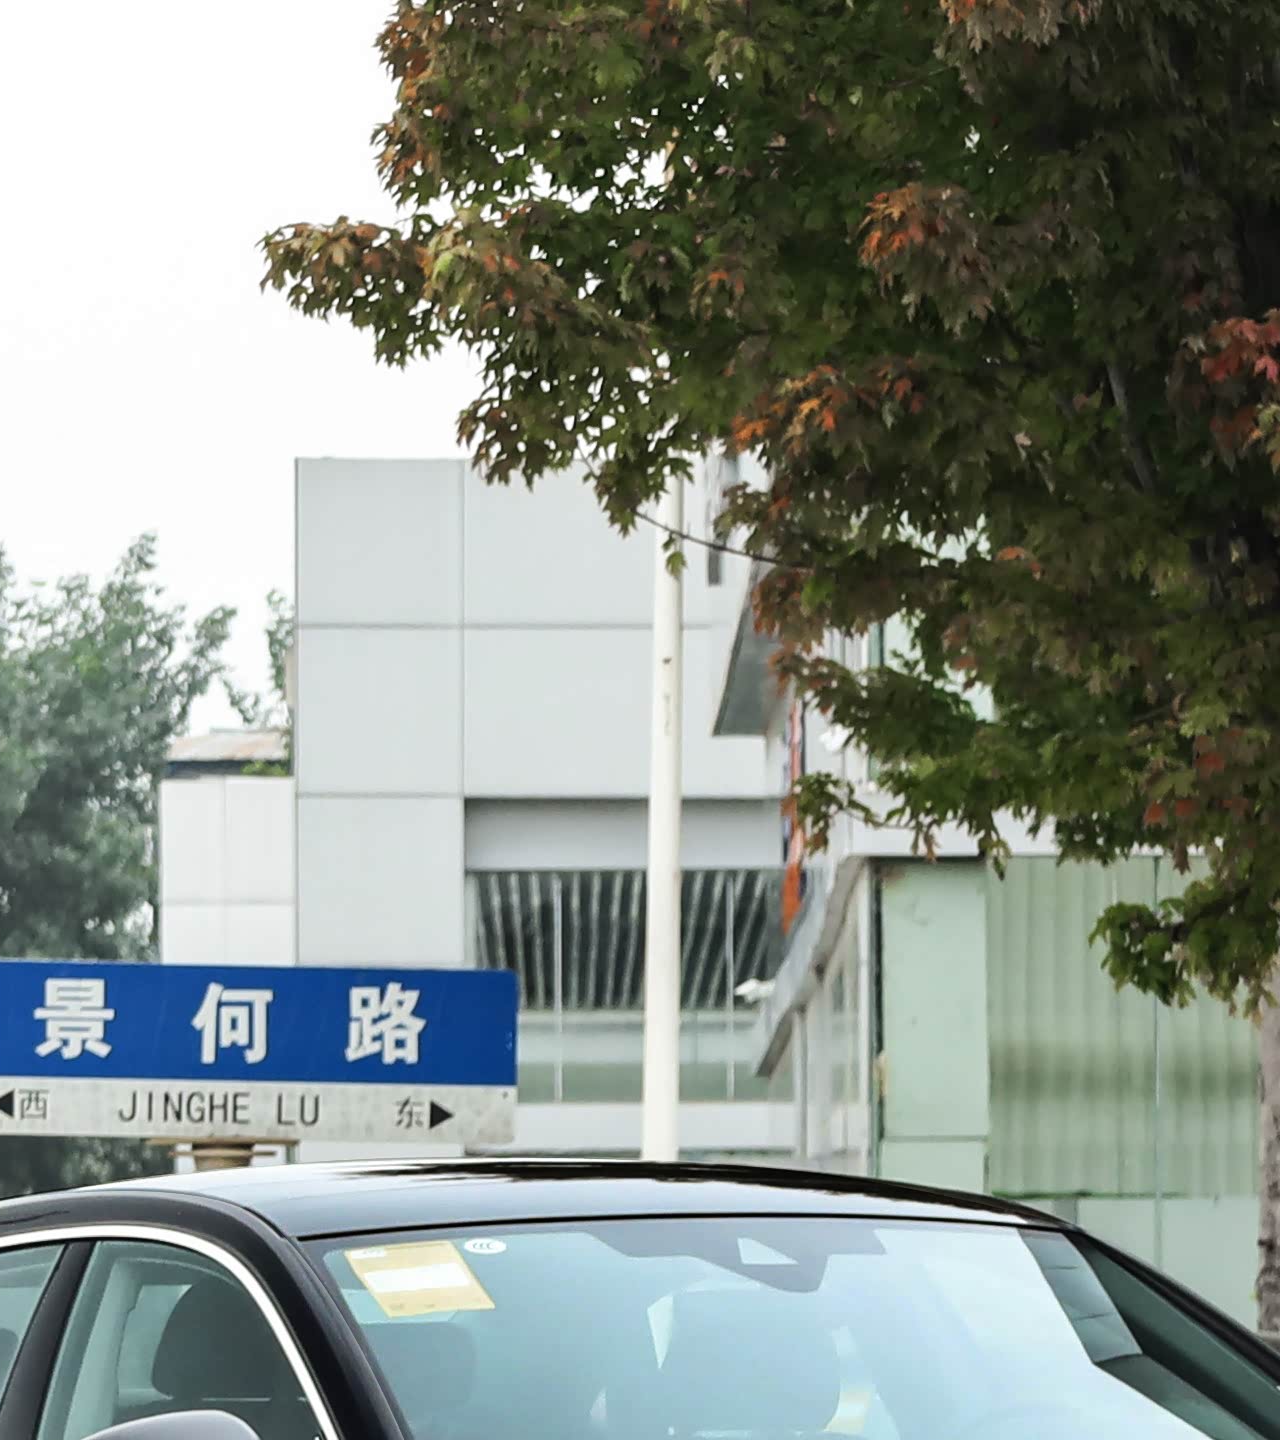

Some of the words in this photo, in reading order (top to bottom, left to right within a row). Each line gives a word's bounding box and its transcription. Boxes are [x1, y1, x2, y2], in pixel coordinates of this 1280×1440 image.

[34, 978, 426, 1064] 景何路
[18, 1088, 48, 1121] 西
[118, 1091, 250, 1125] JINGHE
[276, 1092, 320, 1127] LU
[396, 1097, 423, 1128] 东
